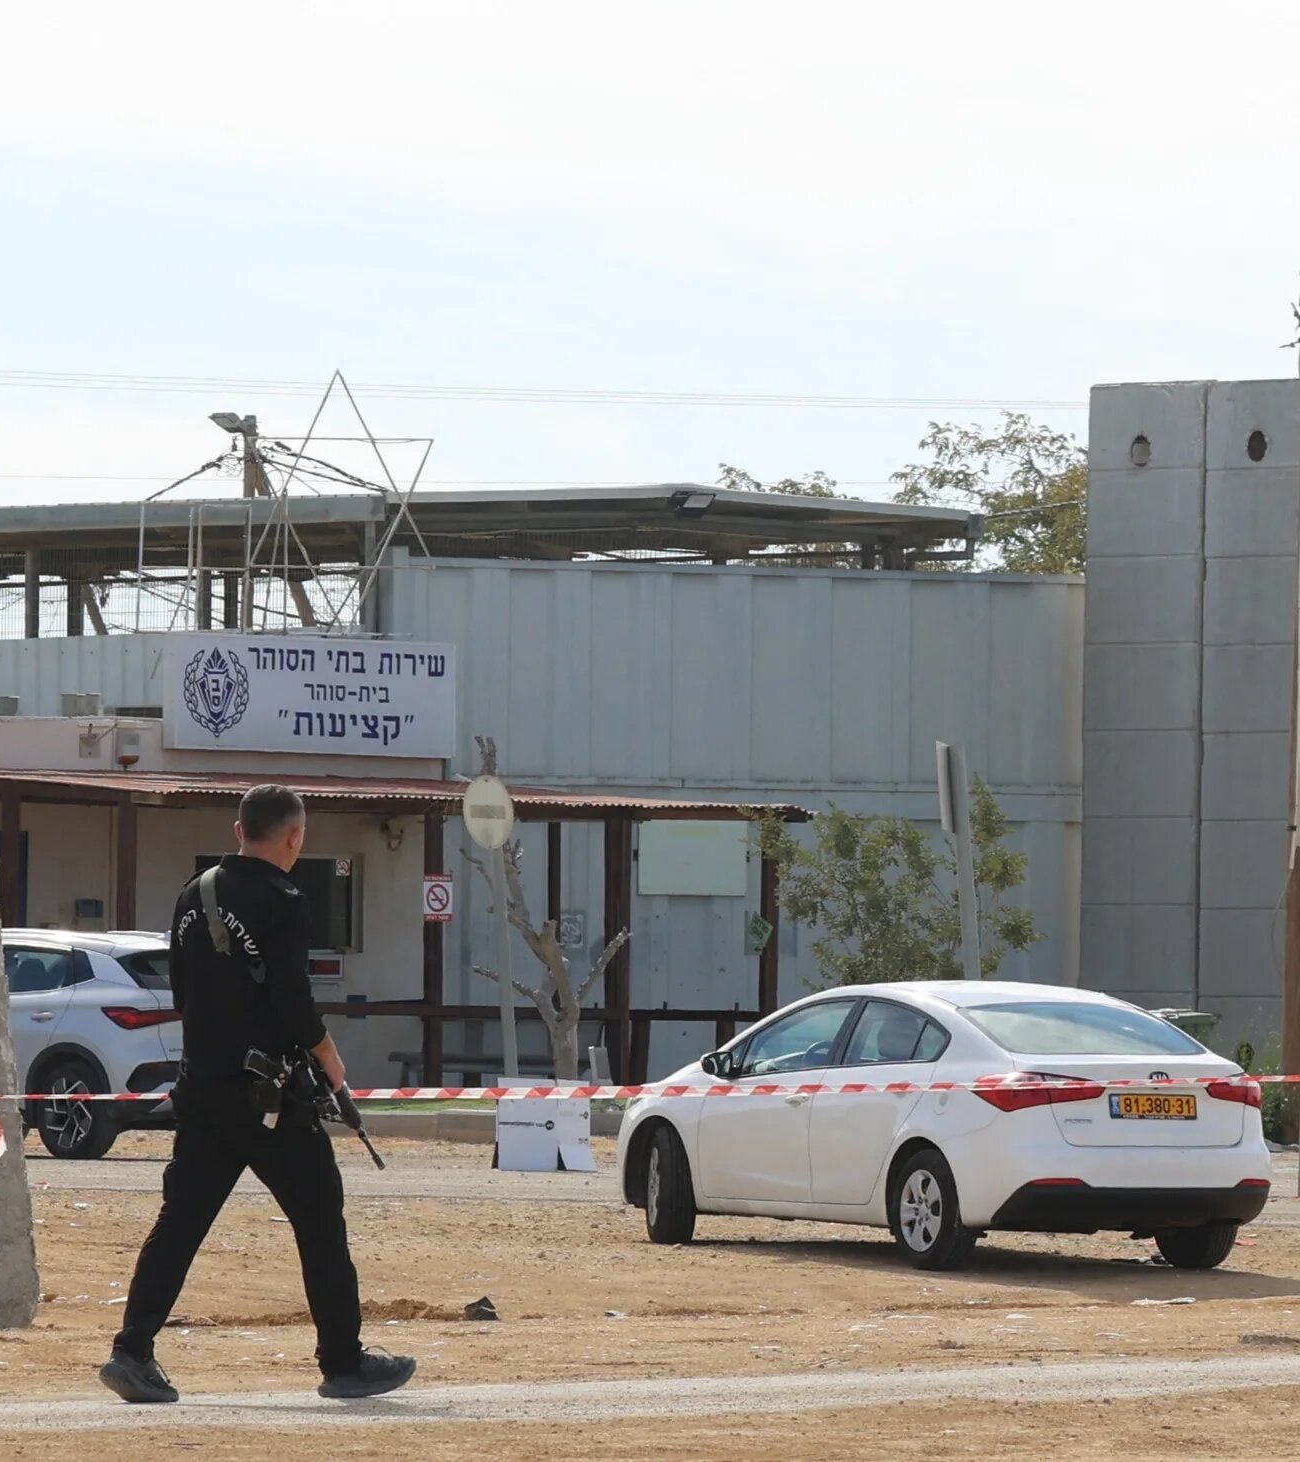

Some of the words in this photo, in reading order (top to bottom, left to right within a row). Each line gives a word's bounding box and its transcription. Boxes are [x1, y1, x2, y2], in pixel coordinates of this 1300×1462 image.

[248, 647, 315, 672] הסוהר
[327, 650, 366, 674] בתי
[377, 652, 446, 678] שירות
[303, 683, 390, 703] בית-סוהר
[278, 709, 415, 745] "קציעות"
[223, 911, 259, 955] שירות
